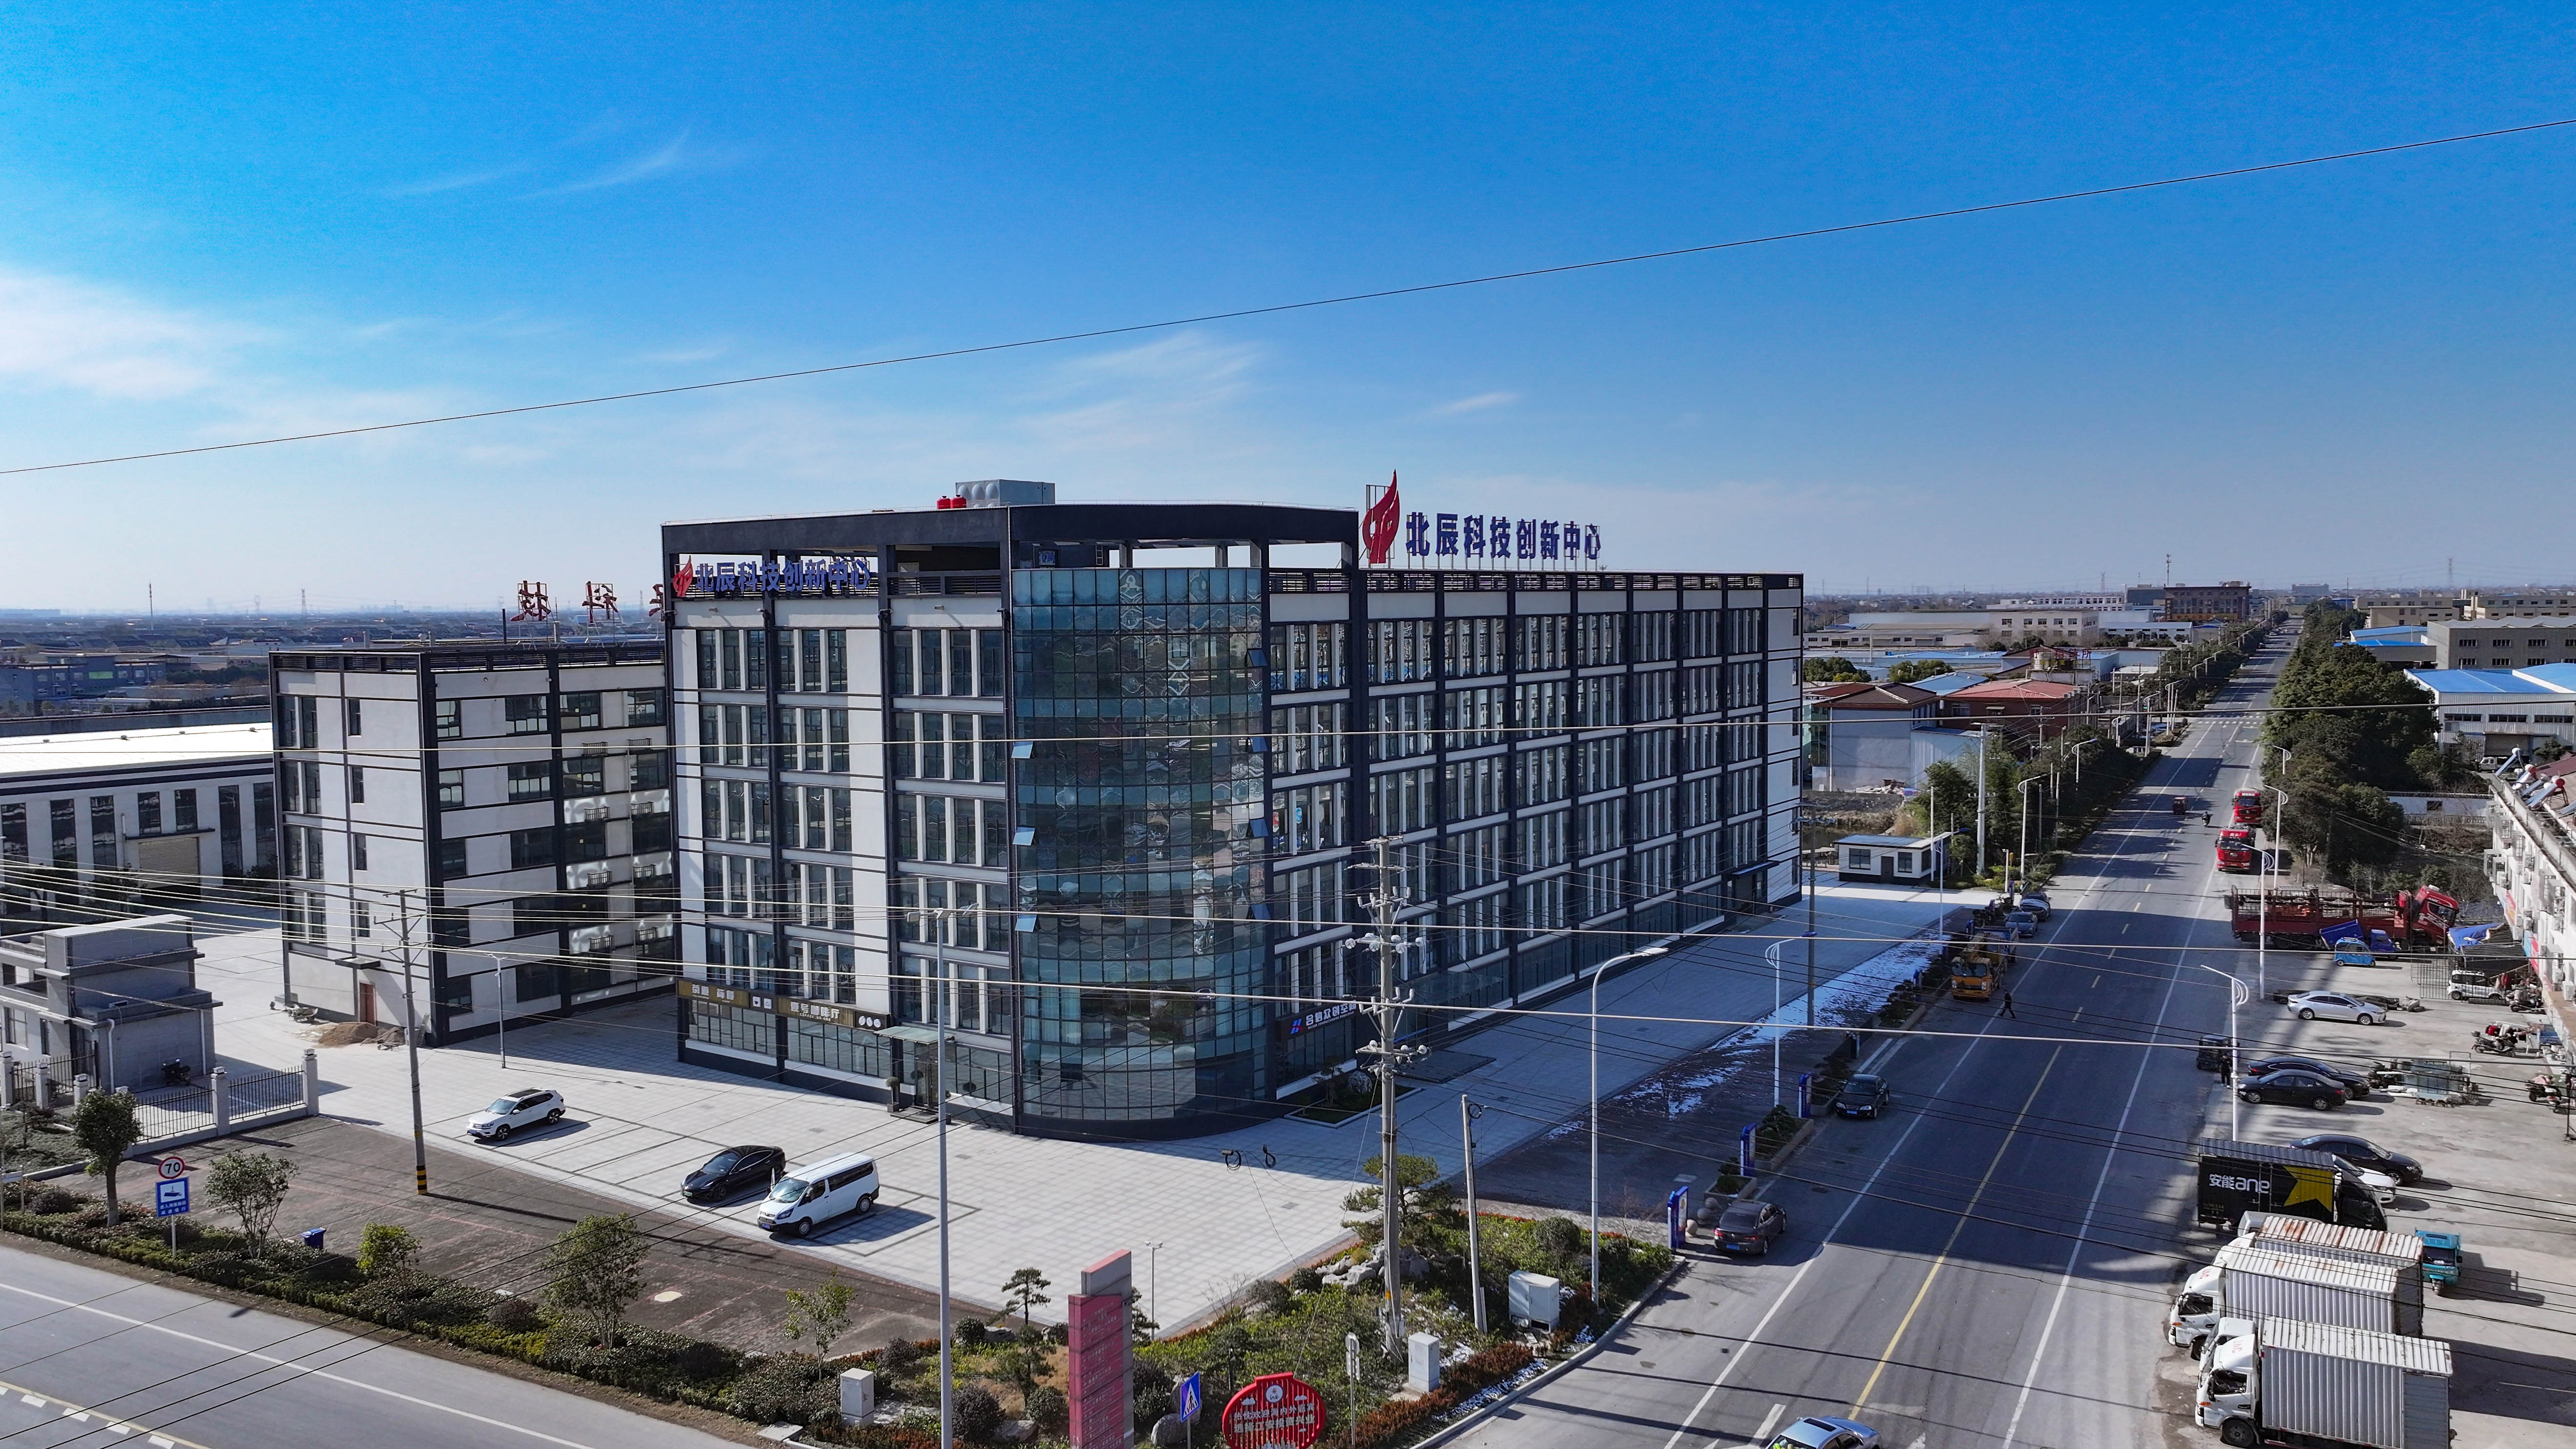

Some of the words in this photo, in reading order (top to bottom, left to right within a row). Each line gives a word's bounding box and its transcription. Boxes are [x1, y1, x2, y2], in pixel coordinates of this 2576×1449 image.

[1406, 512, 1601, 560] 北辰科技创新中心
[695, 558, 870, 592] 北辰科技创新中心
[165, 1162, 181, 1174] 70
[1233, 1403, 1315, 1421] 热忱欢迎海内外嘉宾
